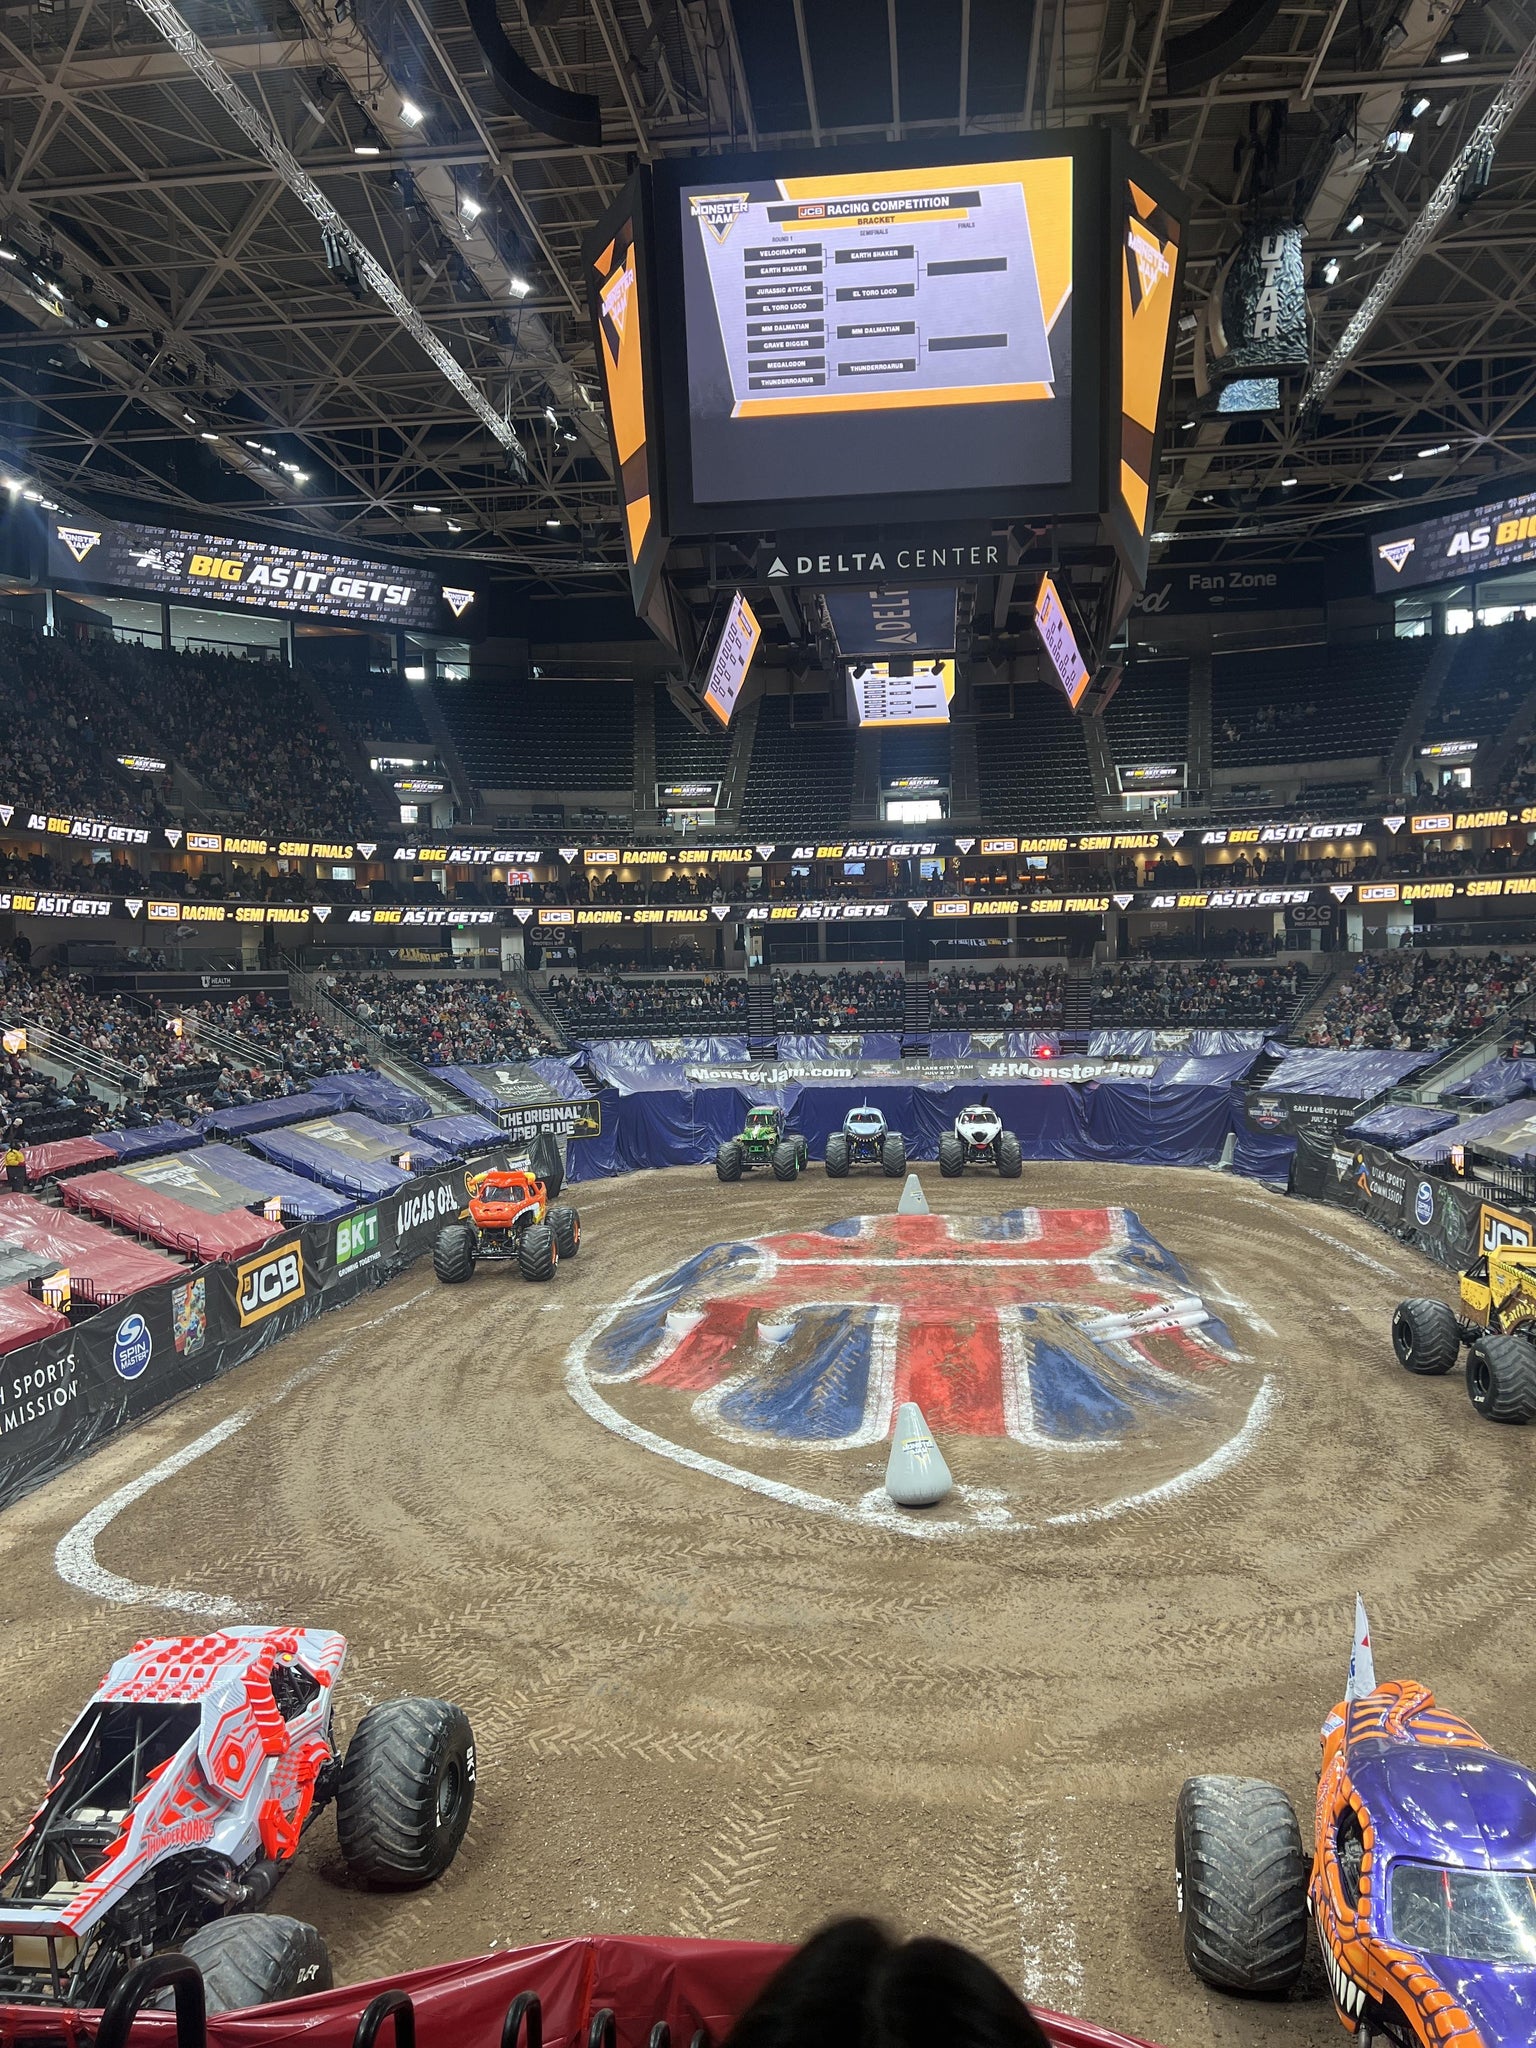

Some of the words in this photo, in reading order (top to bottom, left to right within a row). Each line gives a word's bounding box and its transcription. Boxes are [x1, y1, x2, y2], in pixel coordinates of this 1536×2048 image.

[691, 203, 748, 216] MONSTER
[801, 208, 823, 216] JCB
[827, 201, 869, 215] RACING
[872, 196, 949, 212] COMPETITION
[708, 214, 733, 224] JAM
[858, 216, 895, 225] BRACKET
[760, 248, 806, 257] VELOCIRAPTOR
[782, 265, 807, 273] SHAKER
[757, 287, 786, 295] JURASSIC
[1253, 236, 1284, 341] UTAH
[774, 323, 809, 331] DALMATIAN
[865, 326, 900, 334] DALMATIAN
[767, 361, 806, 369] MEGALODON
[850, 363, 903, 372] THUNDERROARUS
[761, 377, 814, 386] THUNDERROARUS
[58, 533, 100, 545] MONSTER
[1447, 526, 1491, 556] AS
[797, 553, 885, 574] DELTA
[898, 545, 998, 568] CENTER
[188, 555, 244, 581] BIG
[247, 565, 291, 588] AS
[293, 571, 326, 592] IT
[330, 577, 411, 606] GETS!
[1189, 575, 1224, 590] Fan
[1229, 572, 1277, 587] Zone
[28, 814, 46, 830] AS
[47, 817, 70, 833] BIG
[72, 821, 90, 837] AS
[92, 825, 106, 839] IT
[108, 827, 148, 843] GETS!
[1202, 831, 1226, 844] AS
[1229, 830, 1259, 843] BIG
[1261, 827, 1284, 840] AS
[1287, 826, 1309, 839] IT
[1310, 824, 1363, 838] GETS!
[189, 836, 219, 849] JCB
[224, 838, 266, 854] RACING
[279, 843, 309, 856] SEMI
[311, 844, 353, 859] FINALS
[792, 847, 814, 858] AS
[816, 846, 844, 858] BIG
[846, 844, 867, 857] AS
[870, 844, 889, 856] IT
[890, 843, 936, 855] GETS!
[984, 842, 1015, 851] JCB
[1021, 838, 1067, 852] RACING
[1079, 836, 1112, 850] SEMI
[1113, 835, 1159, 848] FINALS
[394, 849, 416, 860] AS
[419, 849, 447, 861] BIG
[449, 850, 471, 862] AS
[473, 851, 492, 862] IT
[493, 851, 540, 863] GETS!
[587, 852, 617, 862] JCB
[623, 851, 666, 863] RACING
[679, 851, 709, 863] SEMI
[711, 849, 752, 861] FINALS
[12, 896, 35, 911] BIG
[37, 898, 55, 912] AS
[56, 900, 71, 913] IT
[72, 900, 110, 915] GETS!
[1292, 906, 1331, 920] G2G
[151, 906, 178, 917] JCB
[182, 906, 225, 920] RACING
[235, 908, 264, 922] SEMI
[267, 908, 309, 923] FINALS
[348, 910, 371, 922] AS
[374, 910, 401, 922] BIG
[403, 912, 425, 922] AS
[427, 912, 447, 923] IT
[448, 911, 494, 923] GETS!
[530, 927, 565, 940] G2G
[691, 1066, 851, 1082] MonsterJam.com
[987, 1062, 1154, 1079] #MonsterJam
[503, 1113, 523, 1127] THE
[524, 1105, 581, 1123] ORIGINAL
[1340, 1109, 1355, 1117] UTAH
[1387, 1173, 1406, 1190] SPORTS
[398, 1196, 434, 1235] LUCAS
[337, 1216, 377, 1256] BKT
[359, 1252, 381, 1267] TOGETHER
[242, 1254, 299, 1311] JCB
[119, 1342, 146, 1359] SPIN
[122, 1353, 147, 1370] MASTER
[14, 1354, 75, 1398] SPORTS
[0, 1384, 77, 1435] MISSION
[467, 1746, 475, 1782] BKT
[142, 1819, 214, 1860] THUNDERROARUS
